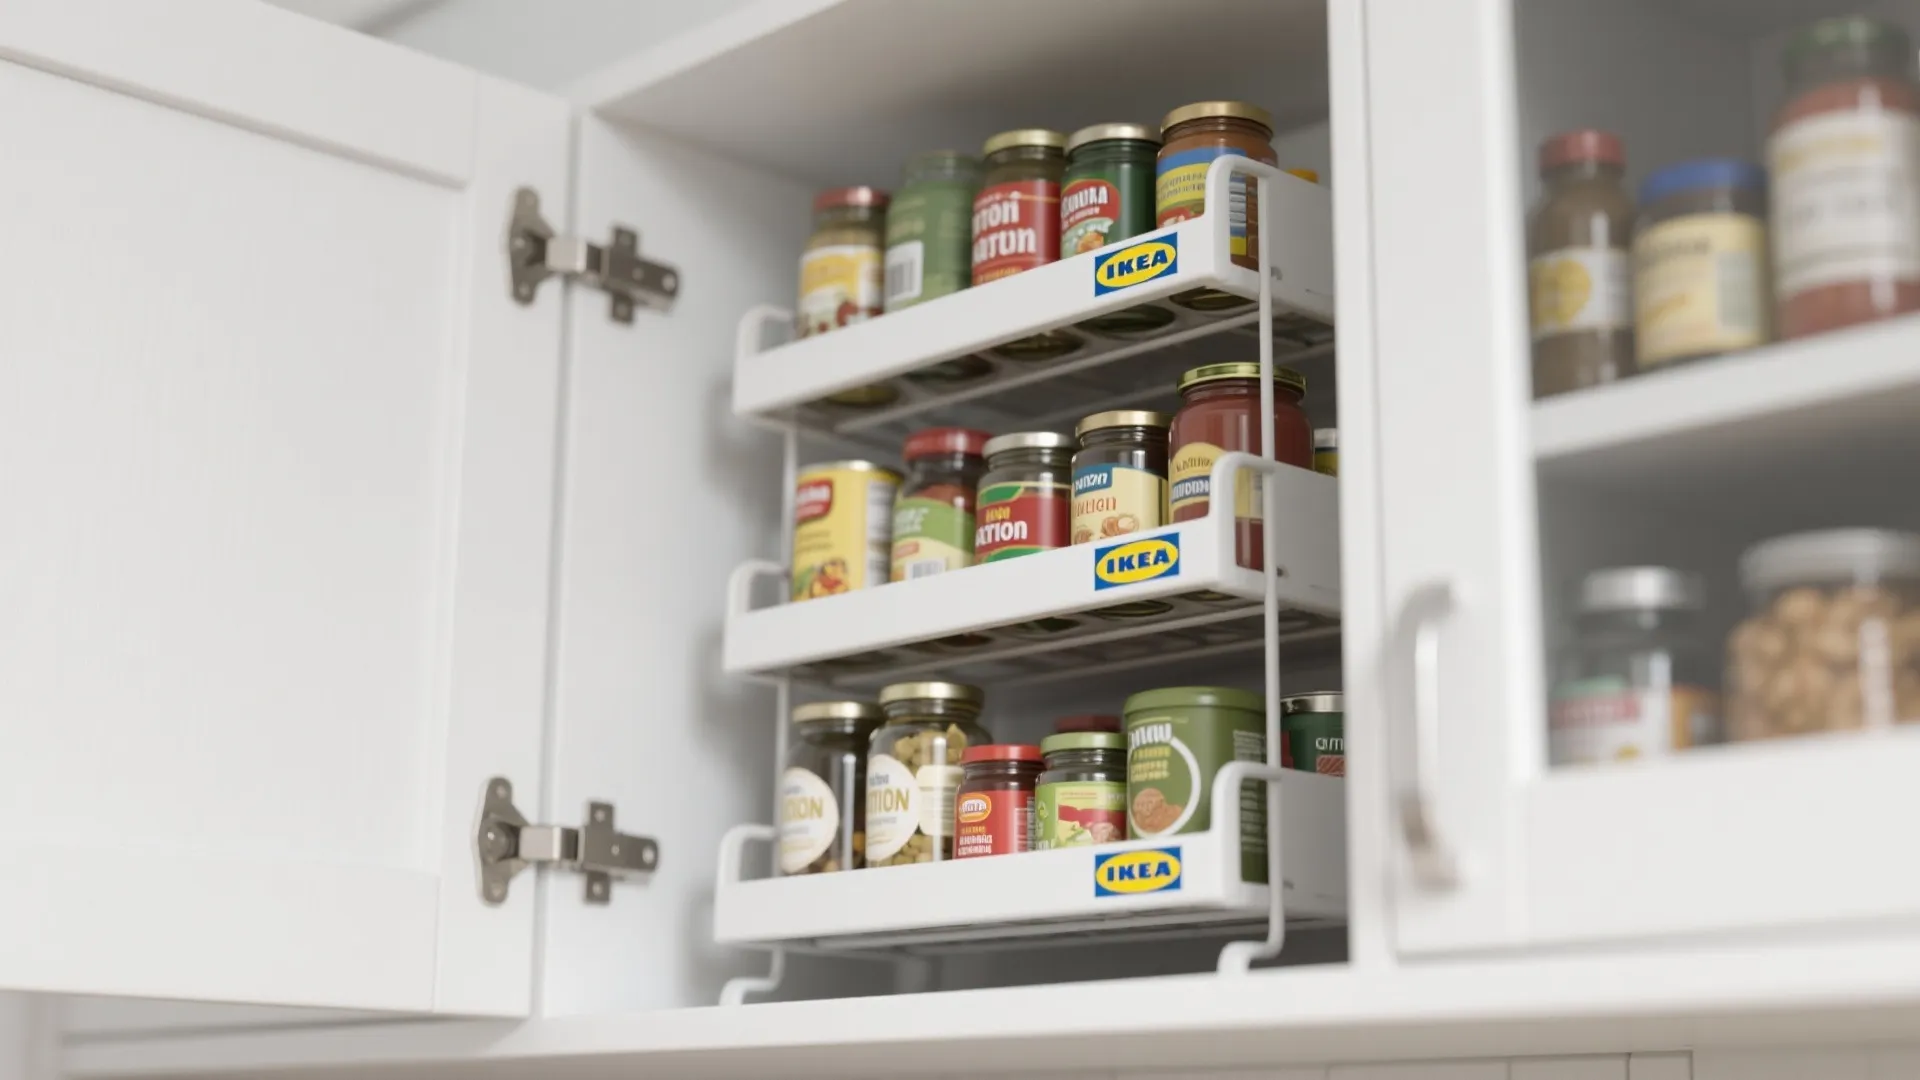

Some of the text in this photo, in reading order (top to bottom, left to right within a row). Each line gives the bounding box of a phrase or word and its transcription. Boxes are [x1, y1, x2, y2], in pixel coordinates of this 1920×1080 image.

[1107, 249, 1168, 280] IKEA
[1107, 548, 1170, 574] IKEA
[1107, 861, 1170, 882] IKEA
